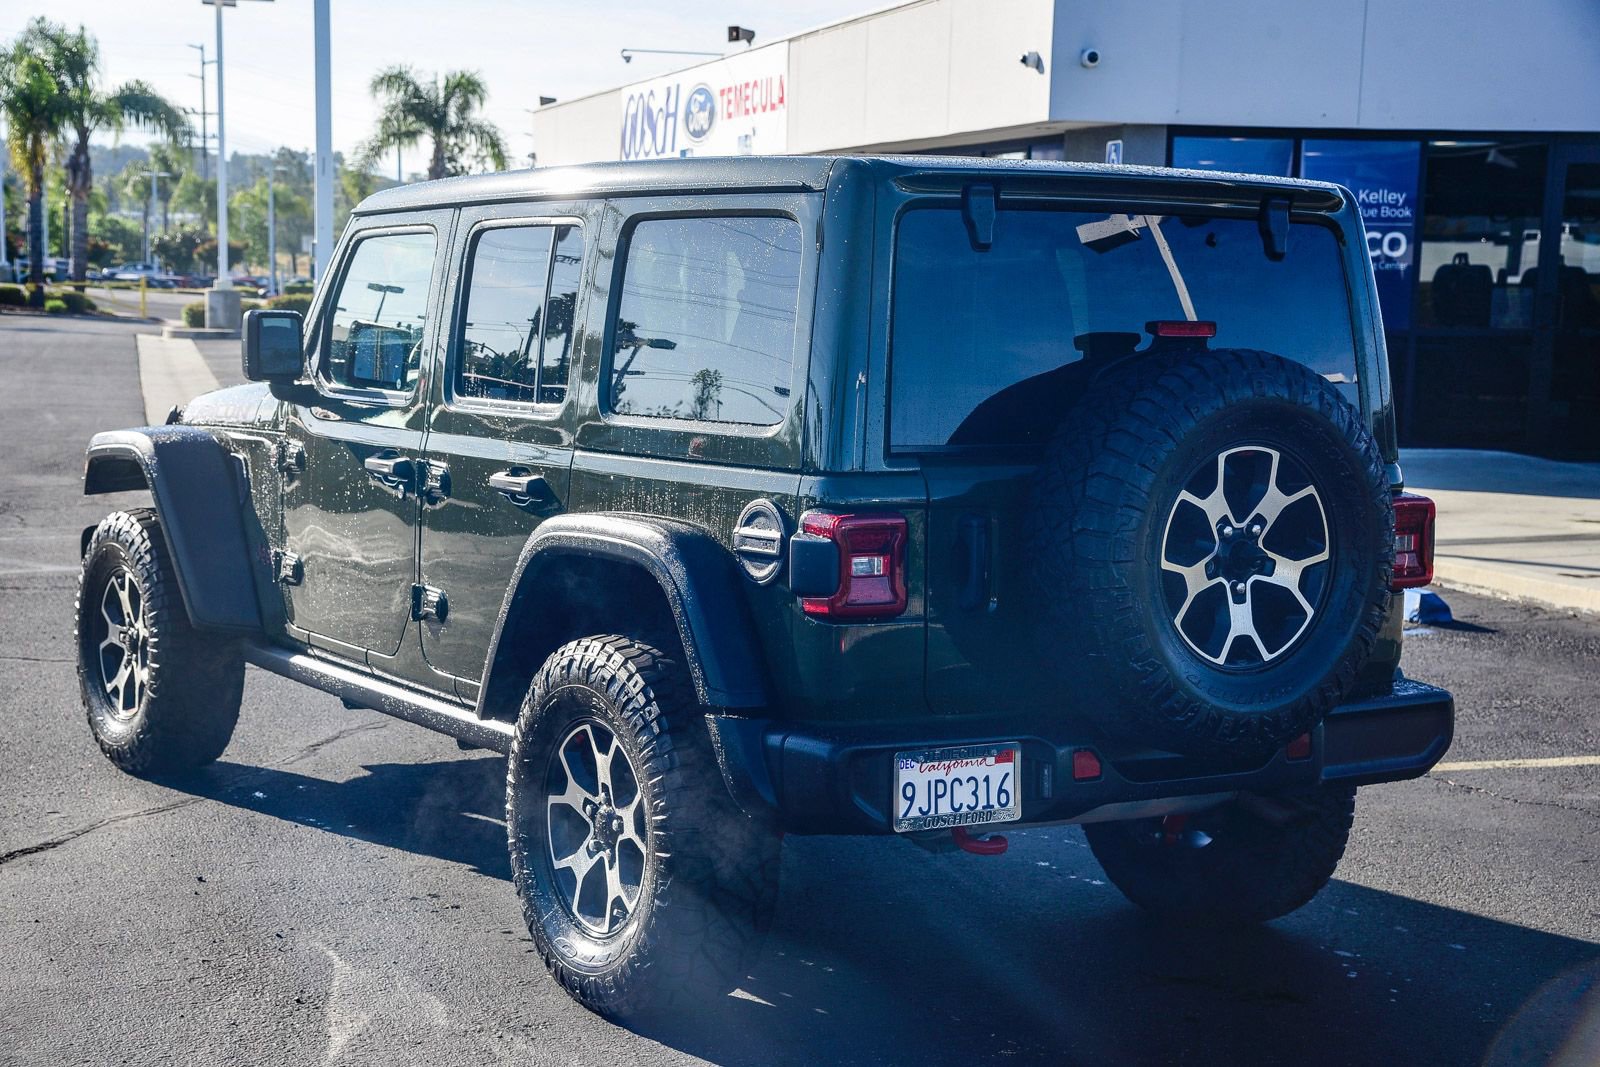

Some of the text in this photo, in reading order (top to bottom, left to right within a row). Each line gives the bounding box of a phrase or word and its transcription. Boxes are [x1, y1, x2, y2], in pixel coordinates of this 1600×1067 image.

[719, 75, 785, 121] TEMECULA
[1358, 188, 1406, 206] Kelley
[1360, 205, 1412, 218] ue Book
[1366, 231, 1407, 258] CO
[900, 759, 915, 770] DEC
[919, 758, 996, 776] California
[901, 772, 1010, 818] 9JPC316
[965, 810, 993, 824] FORD
